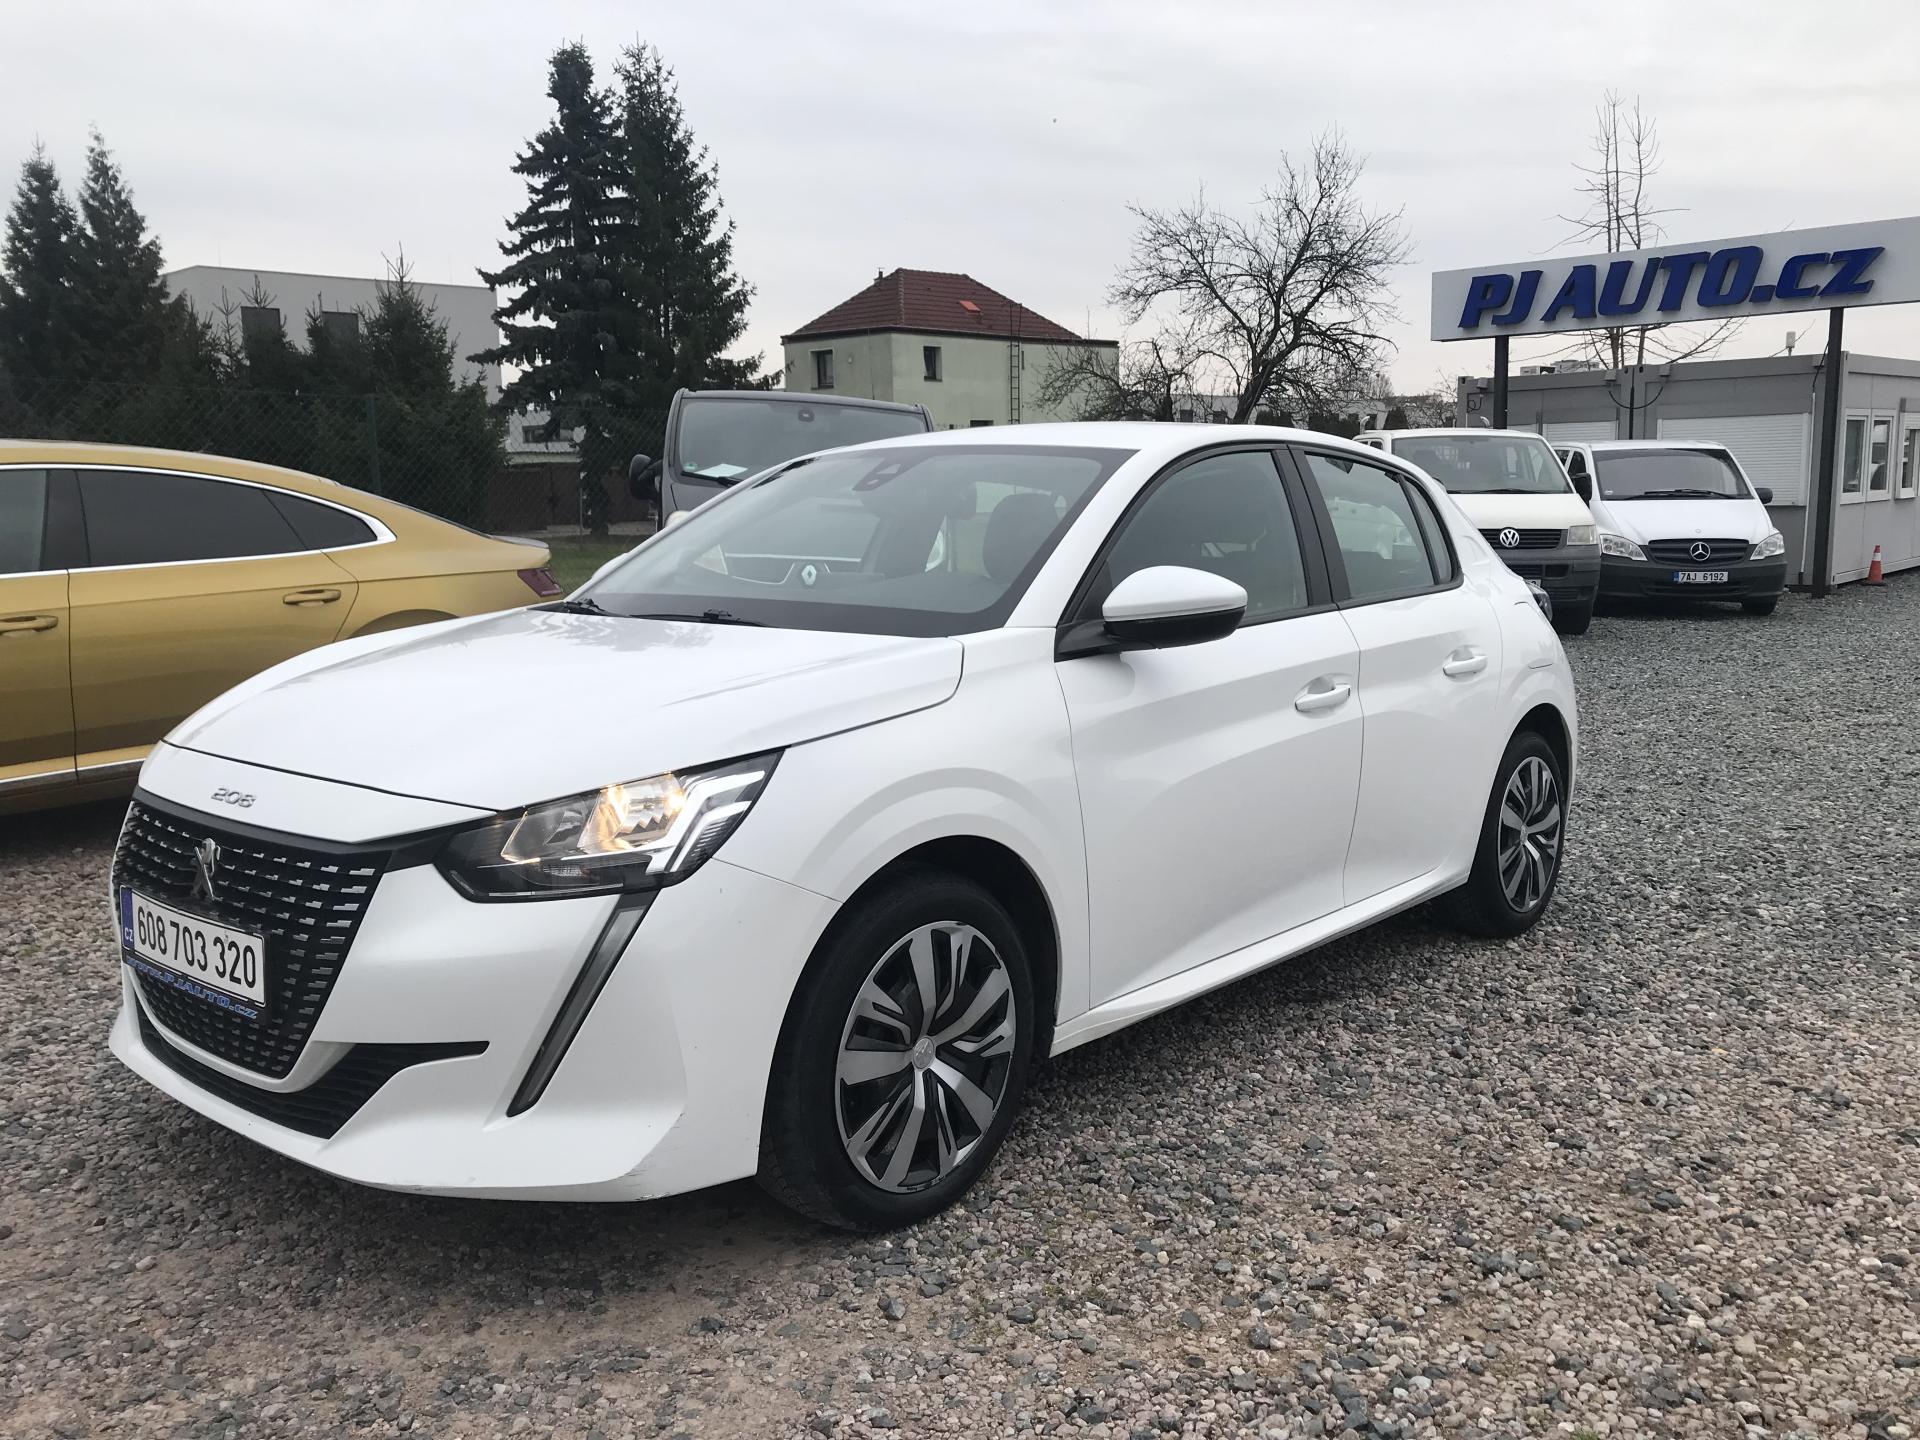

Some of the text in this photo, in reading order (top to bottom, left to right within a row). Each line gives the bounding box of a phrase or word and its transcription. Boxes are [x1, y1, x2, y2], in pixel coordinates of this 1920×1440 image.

[1458, 269, 1543, 328] PJ
[1681, 572, 1697, 581] 7AJ
[1703, 572, 1724, 581] 6192
[210, 787, 257, 808] 208
[124, 905, 256, 988] CZ 608 703 320
